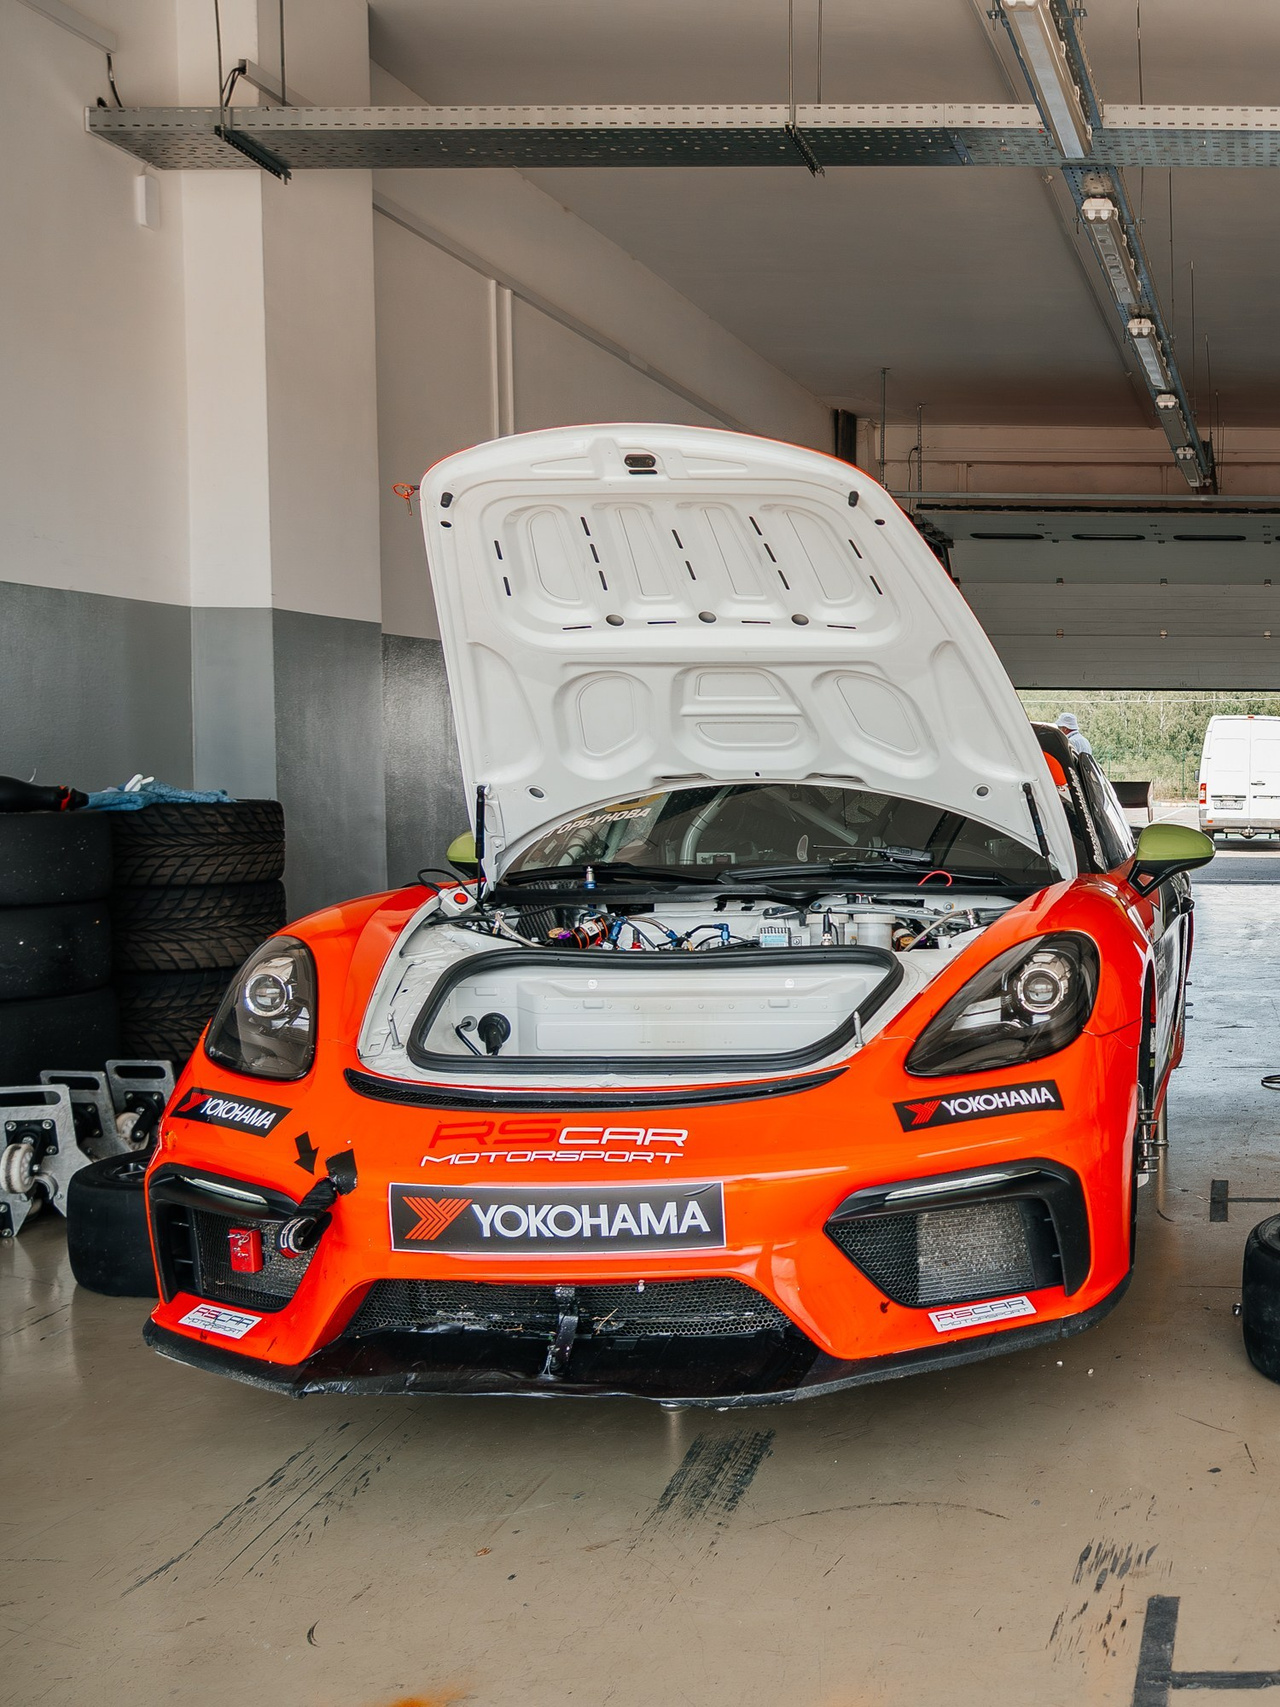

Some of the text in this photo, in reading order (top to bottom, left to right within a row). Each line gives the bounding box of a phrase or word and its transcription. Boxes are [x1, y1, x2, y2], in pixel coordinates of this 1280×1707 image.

[941, 1086, 1056, 1117] YOKOHAMA
[200, 1097, 277, 1129] YOKOHAMA
[419, 1150, 684, 1167] MOTORSPORT
[471, 1200, 711, 1238] YOKOHAMA
[192, 1307, 255, 1328] RSCAR
[935, 1299, 1025, 1322] RSCAR
[940, 1306, 1029, 1328] MOTORSPORT
[184, 1316, 244, 1334] MOTORSPORT
